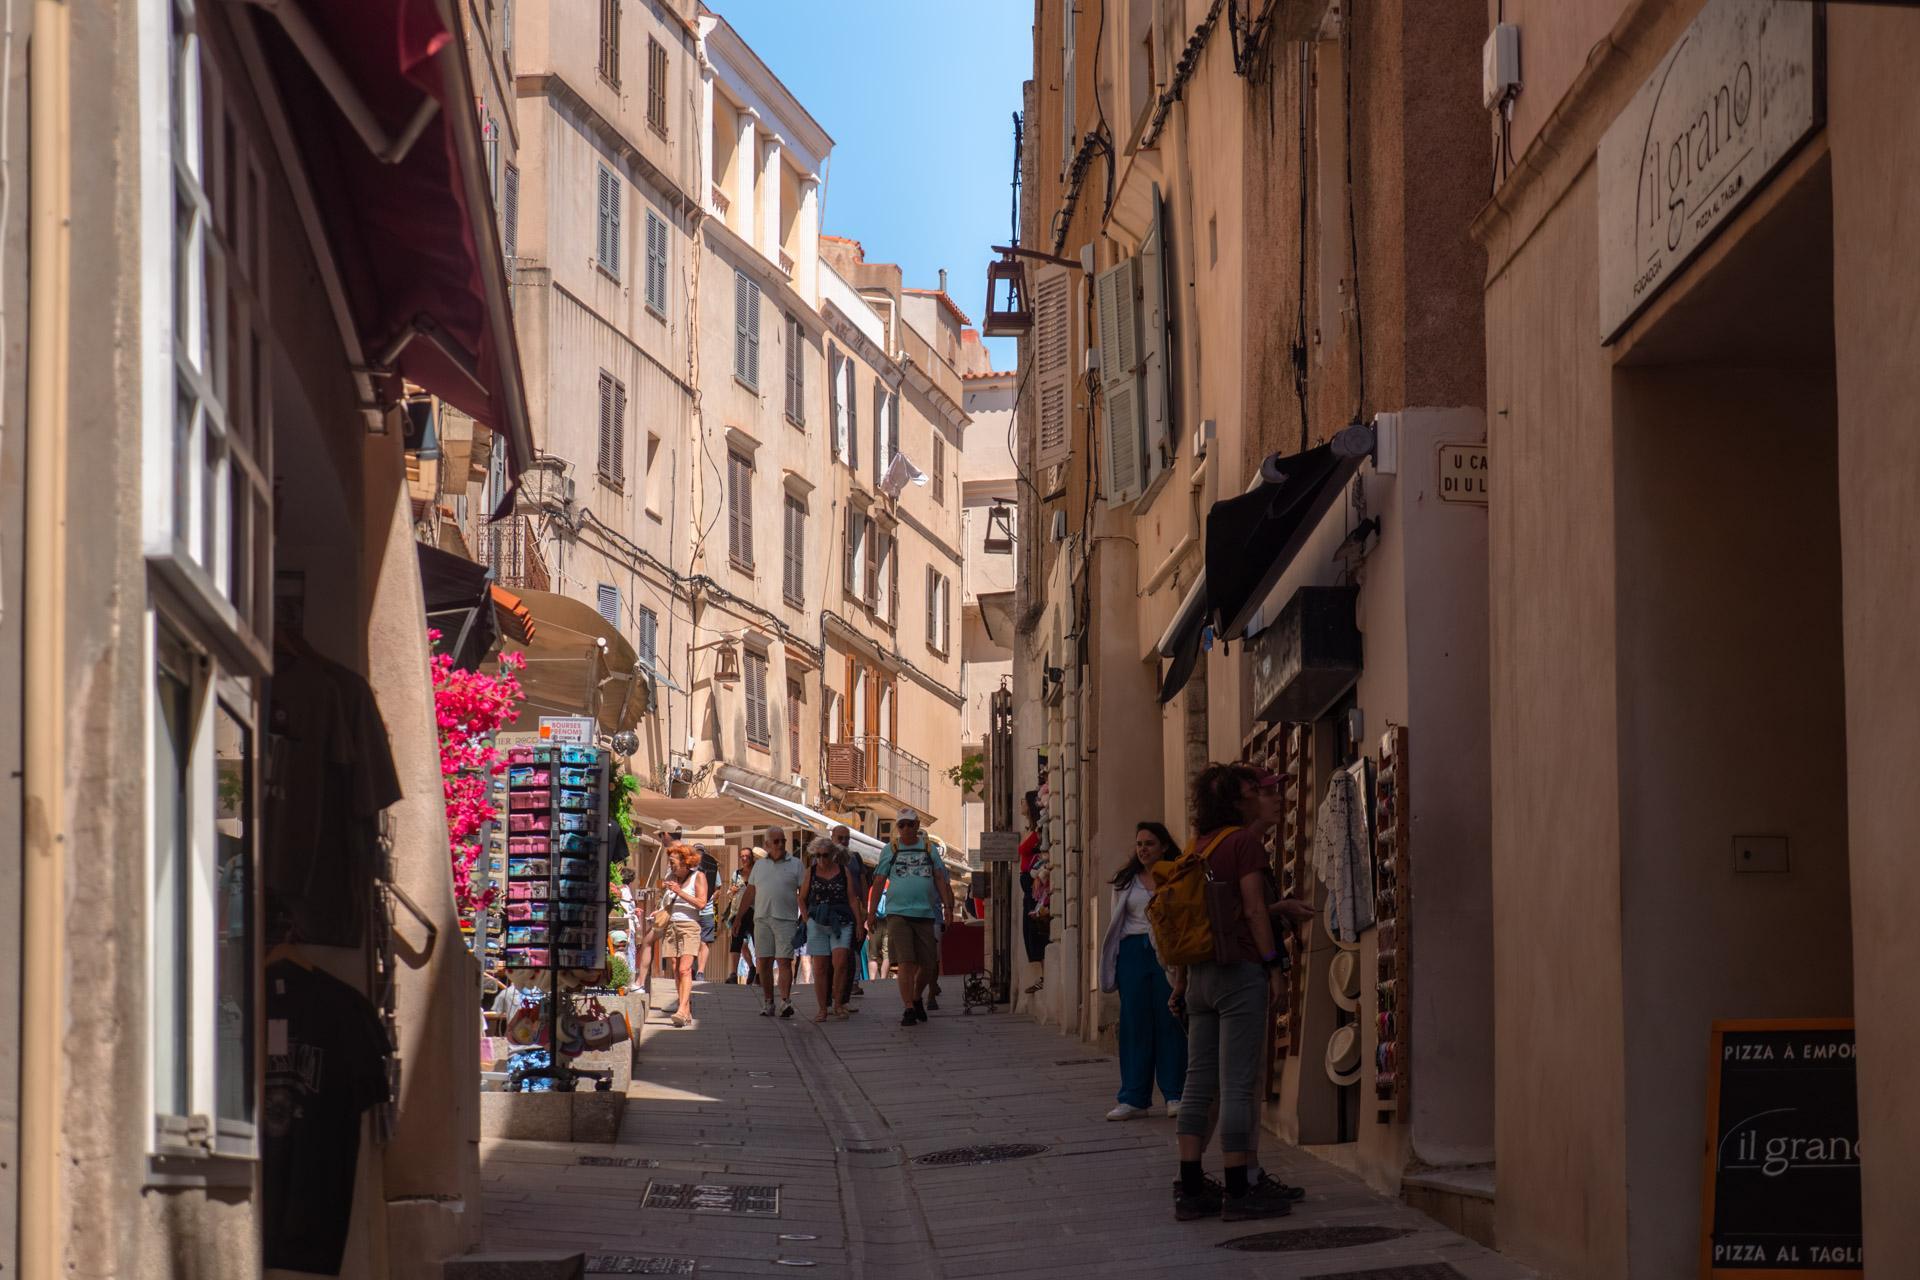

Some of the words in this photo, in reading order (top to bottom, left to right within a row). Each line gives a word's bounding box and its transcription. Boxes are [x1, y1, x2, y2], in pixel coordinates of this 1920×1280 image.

[1650, 142, 1661, 228] il
[1667, 61, 1751, 251] grano
[1454, 454, 1462, 469] U
[1470, 455, 1488, 470] CA
[1444, 477, 1458, 492] DI
[1465, 478, 1473, 492] U
[1479, 478, 1487, 493] L
[1724, 1045, 1774, 1060] PIZZA
[1738, 1130, 1756, 1160] il
[1715, 1245, 1766, 1262] PIZZA
[1776, 1246, 1799, 1262] AL
